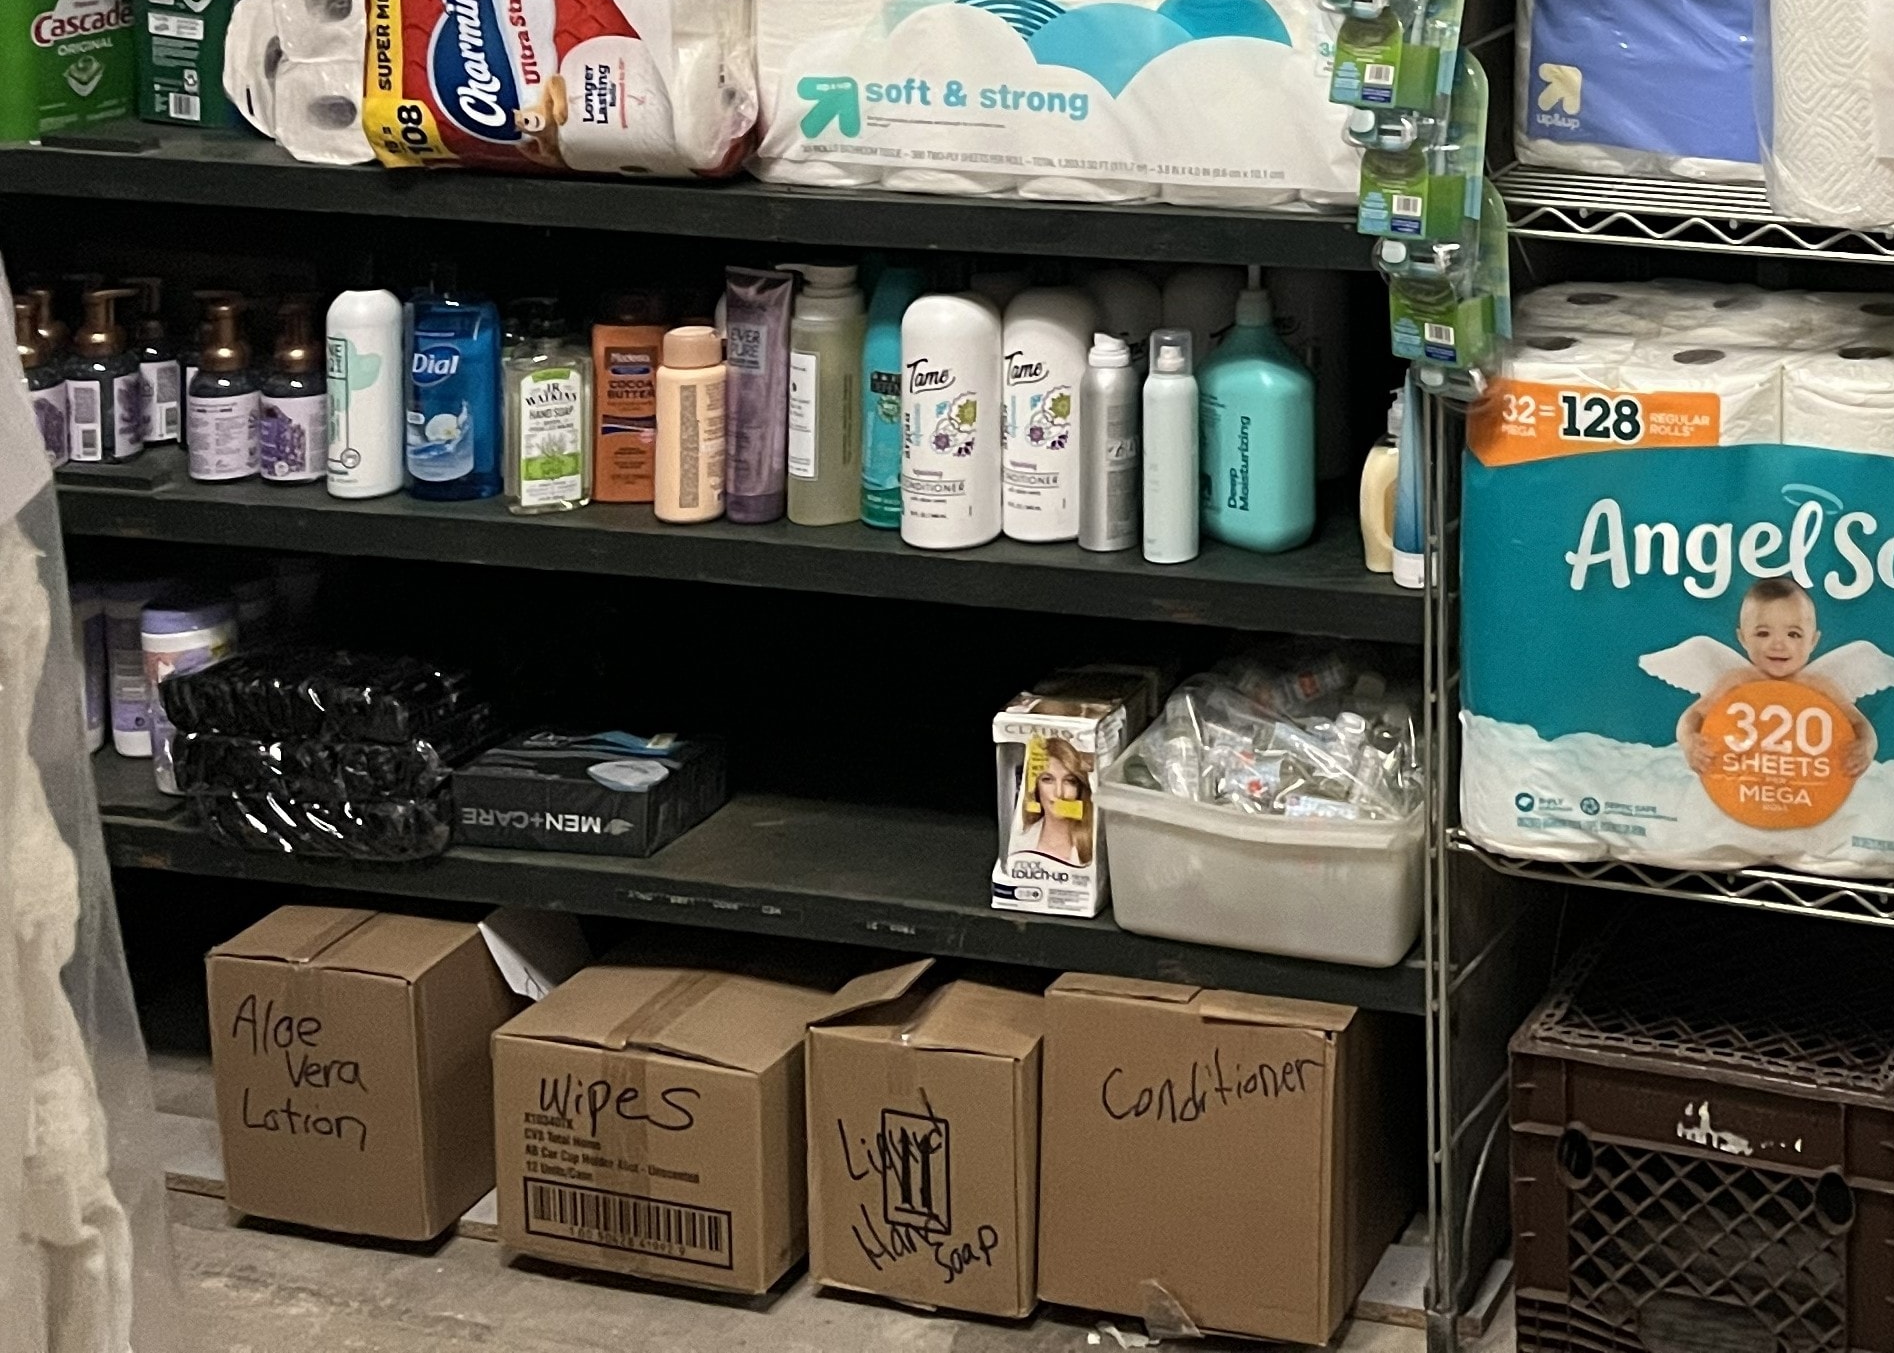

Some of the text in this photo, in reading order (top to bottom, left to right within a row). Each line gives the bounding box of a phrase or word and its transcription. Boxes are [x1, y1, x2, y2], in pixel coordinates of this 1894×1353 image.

[377, 24, 392, 92] SUPER
[516, 31, 541, 85] Ultra
[582, 64, 596, 124] Longer
[597, 64, 611, 125] Lasting
[866, 78, 1089, 121] soft & strong
[397, 103, 428, 155] 108
[412, 353, 460, 376] Dial
[1502, 394, 1641, 441] 32 128
[1650, 413, 1710, 426] REGULAR
[1228, 467, 1239, 509] Deep
[1239, 415, 1251, 511] Moisturizing
[1566, 498, 1826, 599] Angel
[1723, 701, 1834, 756] 320
[1722, 752, 1831, 779] SHEETS
[462, 807, 602, 835] MEN+CARE
[1739, 782, 1813, 808] MEGA
[1011, 867, 1070, 883] touch-up
[232, 993, 323, 1056] Aloe
[285, 1048, 368, 1092] Vera
[1102, 1046, 1326, 1124] Conditioner
[242, 1088, 368, 1151] Lotion
[539, 1073, 701, 1138] Wipes
